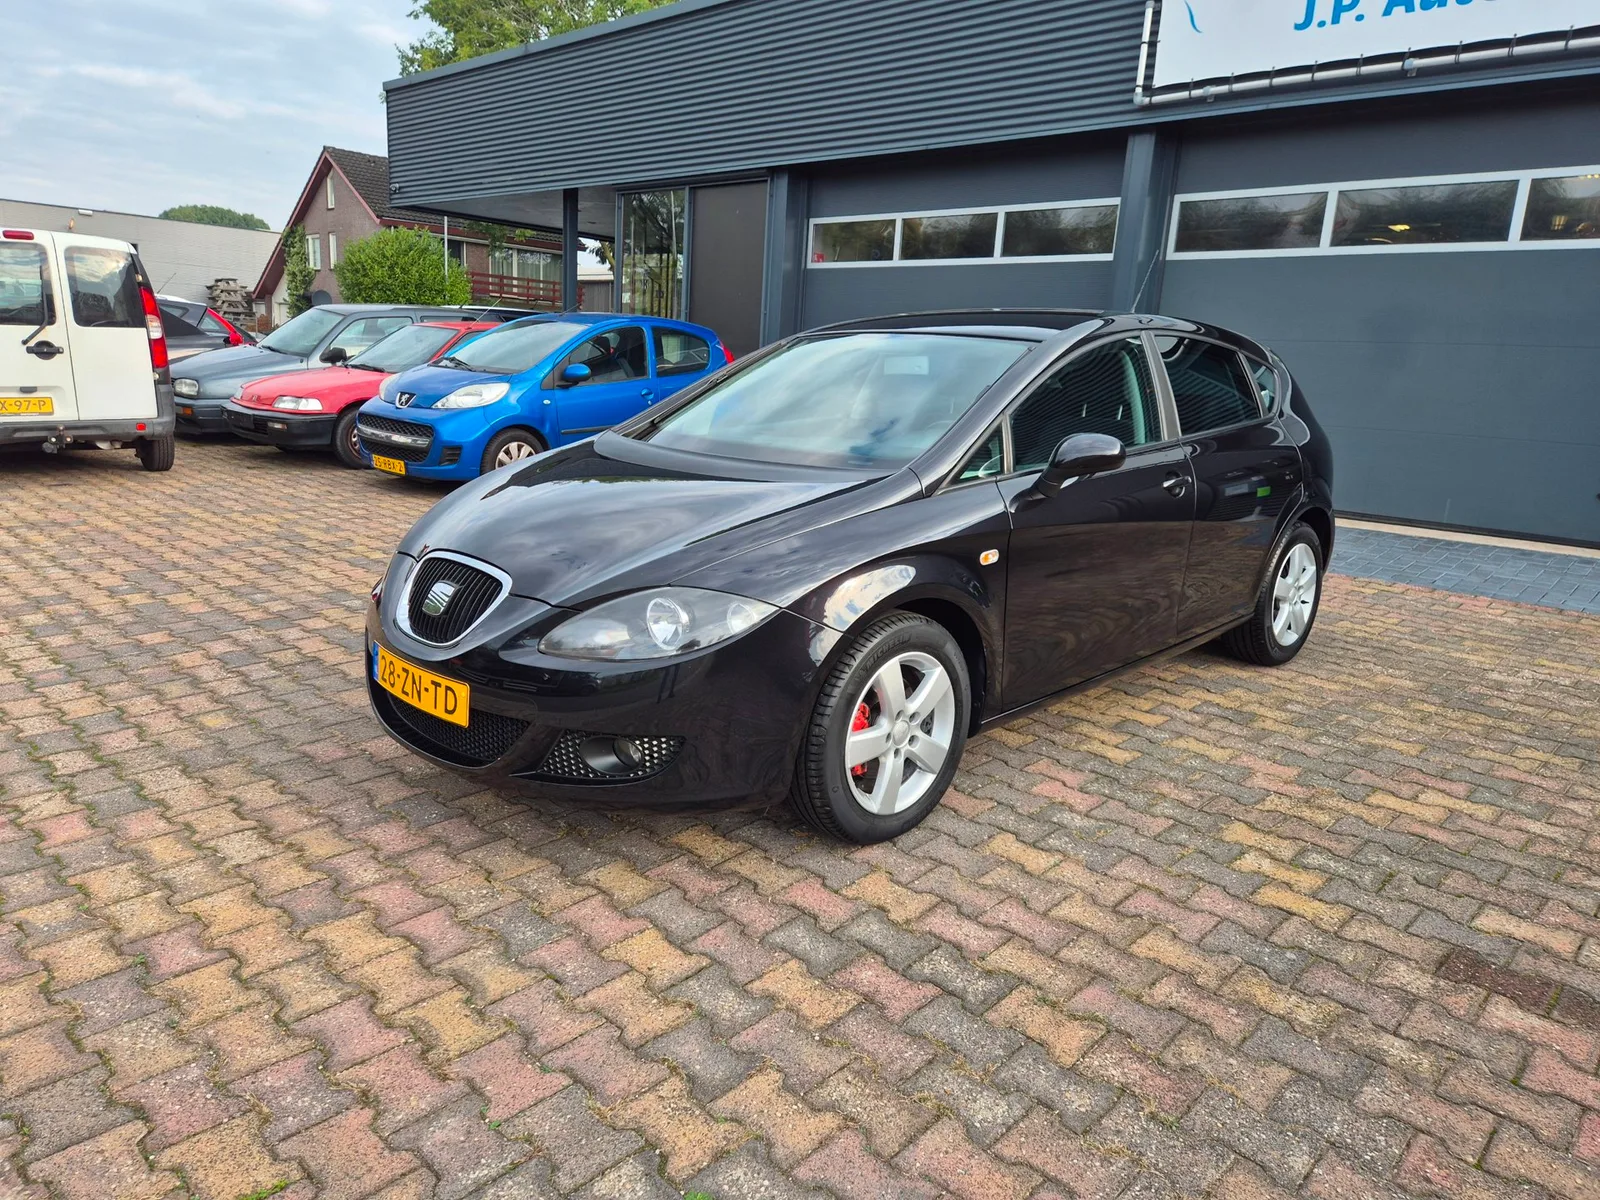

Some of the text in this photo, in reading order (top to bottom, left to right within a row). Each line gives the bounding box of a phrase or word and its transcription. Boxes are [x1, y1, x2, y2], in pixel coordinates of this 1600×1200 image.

[1294, 0, 1365, 31] J.P.
[0, 399, 47, 411] X-97-P
[381, 655, 458, 715] 28-ZN-TD
